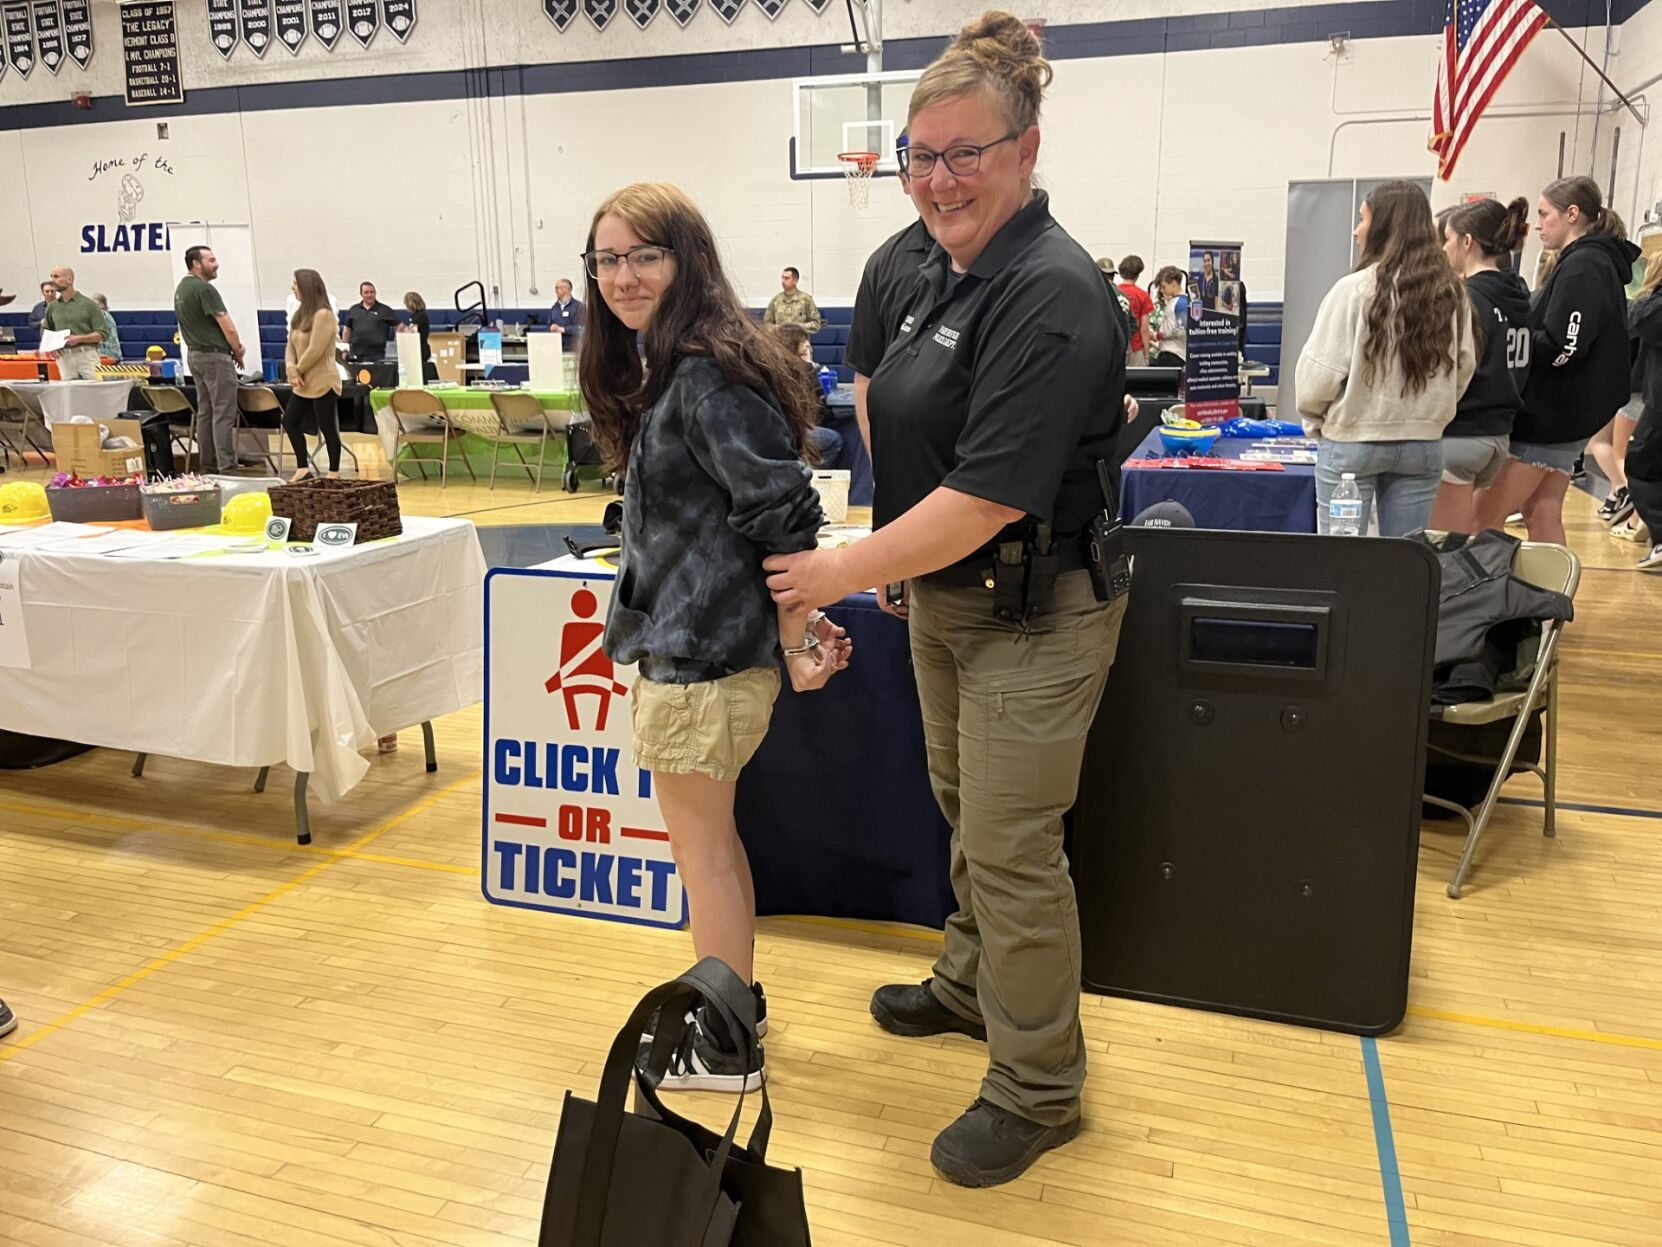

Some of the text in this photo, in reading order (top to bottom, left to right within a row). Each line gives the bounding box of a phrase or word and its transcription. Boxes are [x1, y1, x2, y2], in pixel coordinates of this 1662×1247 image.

[122, 8, 142, 18] CLASS
[144, 7, 153, 16] OF
[352, 7, 371, 17] 2017
[389, 3, 409, 13] 2024
[282, 17, 300, 25] 2001
[317, 12, 336, 21] 2011
[247, 21, 267, 29] 2000
[150, 34, 169, 45] CLASS
[144, 47, 176, 60] CHAMPIONS
[131, 64, 158, 74] FOOTBALL
[128, 74, 176, 86] BASKETBALL 20-1
[131, 87, 175, 98] BASEBALL 14-1
[88, 153, 174, 181] Home of the
[1506, 327, 1530, 369] 20
[494, 738, 620, 796] CLICK
[558, 804, 611, 845] OR
[494, 840, 677, 912] TICKET
